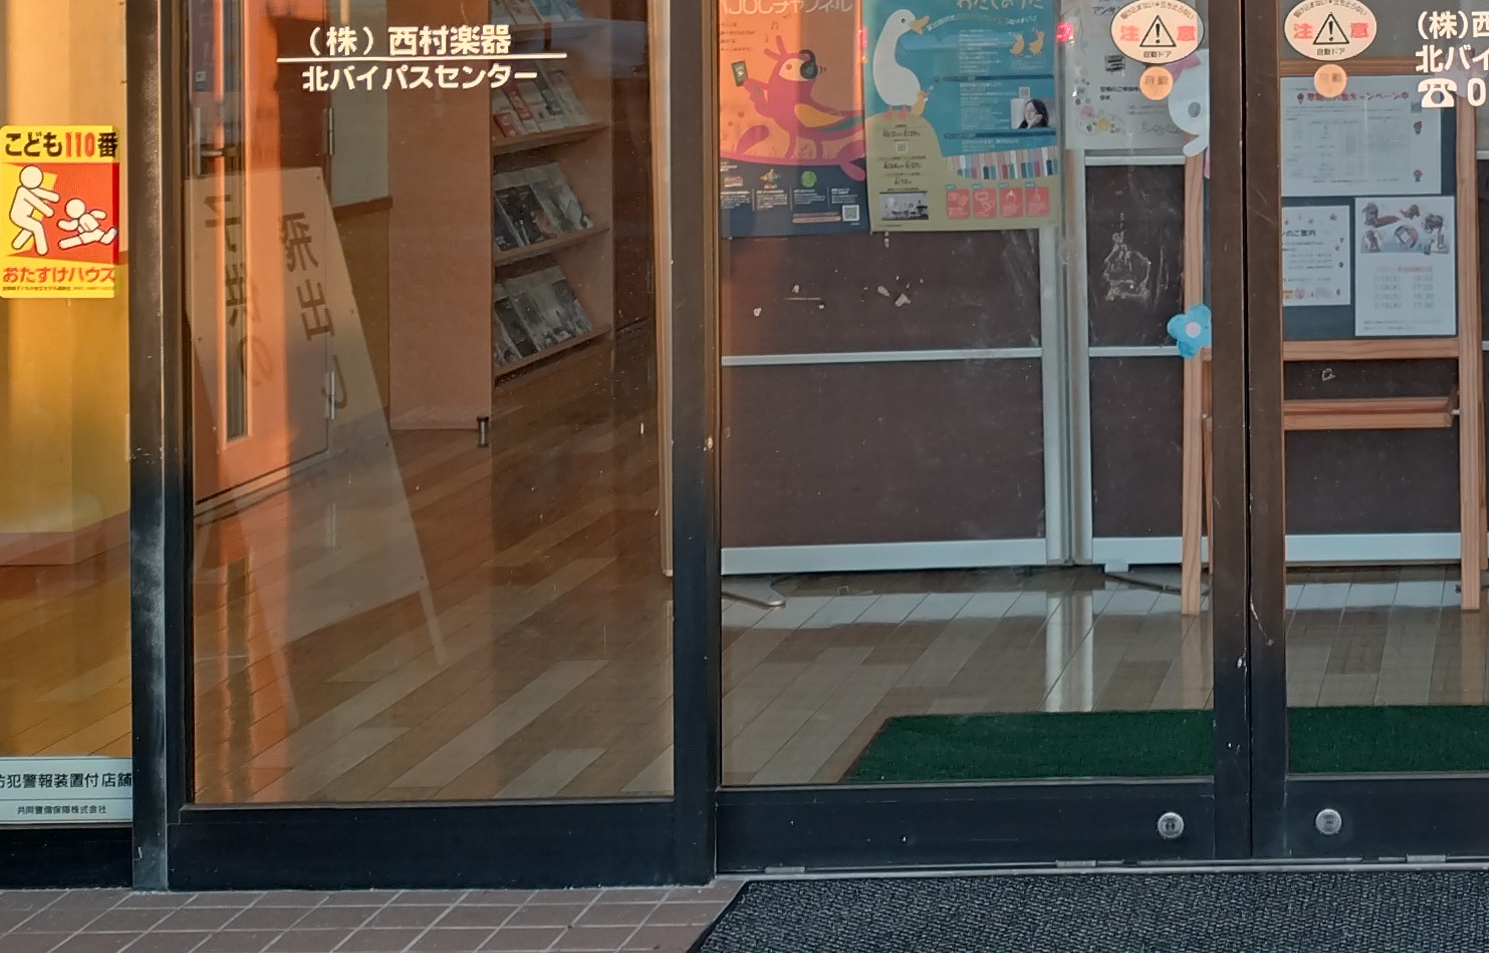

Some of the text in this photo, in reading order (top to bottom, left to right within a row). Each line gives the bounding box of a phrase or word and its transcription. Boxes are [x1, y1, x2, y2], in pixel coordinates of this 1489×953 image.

[1119, 25, 1140, 42] 注
[1293, 23, 1313, 39] 注
[302, 64, 539, 93] 北バイパスセンター
[5, 131, 119, 158] こども110番
[2, 266, 115, 284] おたすけハウス
